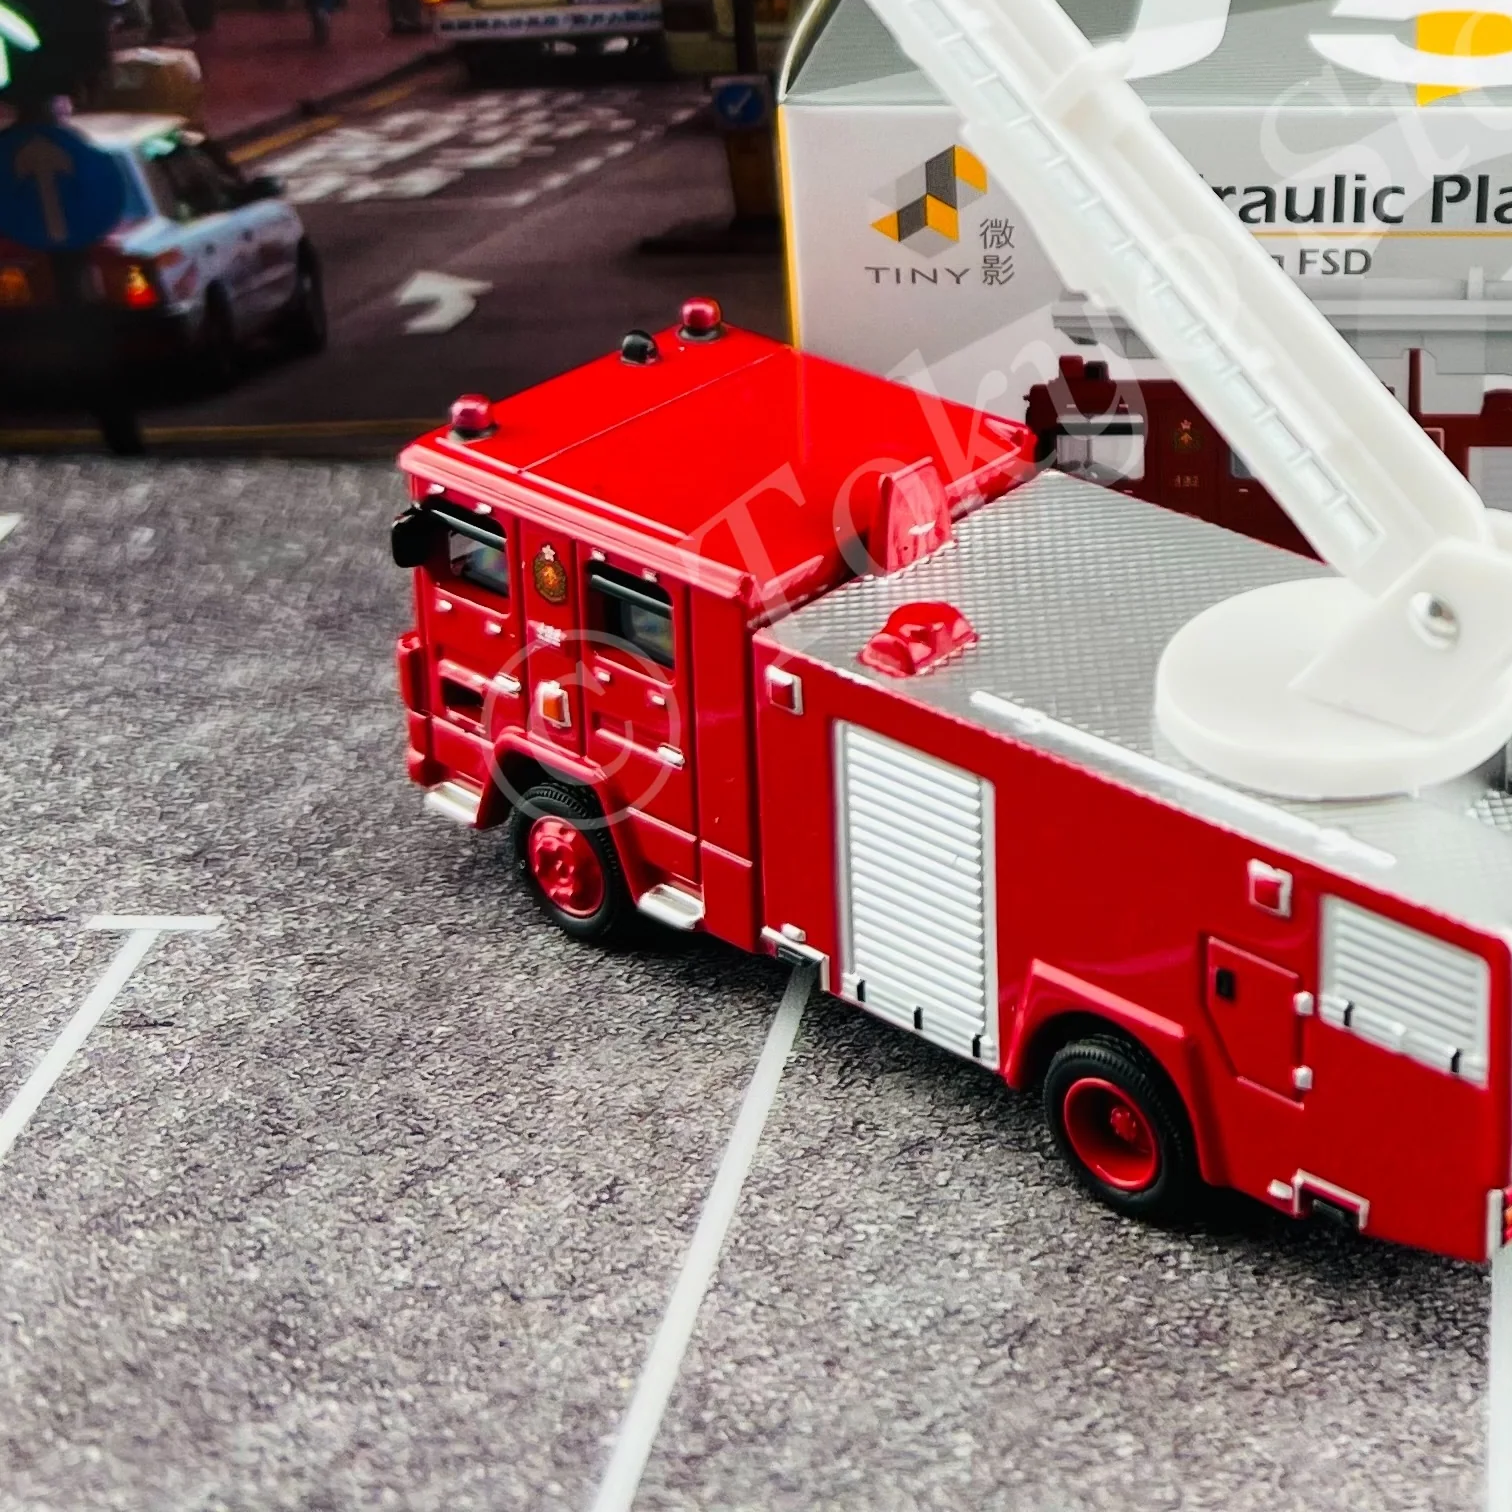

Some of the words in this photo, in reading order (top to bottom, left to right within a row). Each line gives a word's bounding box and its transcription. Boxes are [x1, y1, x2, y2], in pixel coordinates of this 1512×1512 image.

[1199, 173, 1405, 225] raulic
[979, 217, 1015, 286] 微影
[1299, 248, 1372, 275] FSD
[864, 266, 971, 285] TINY
